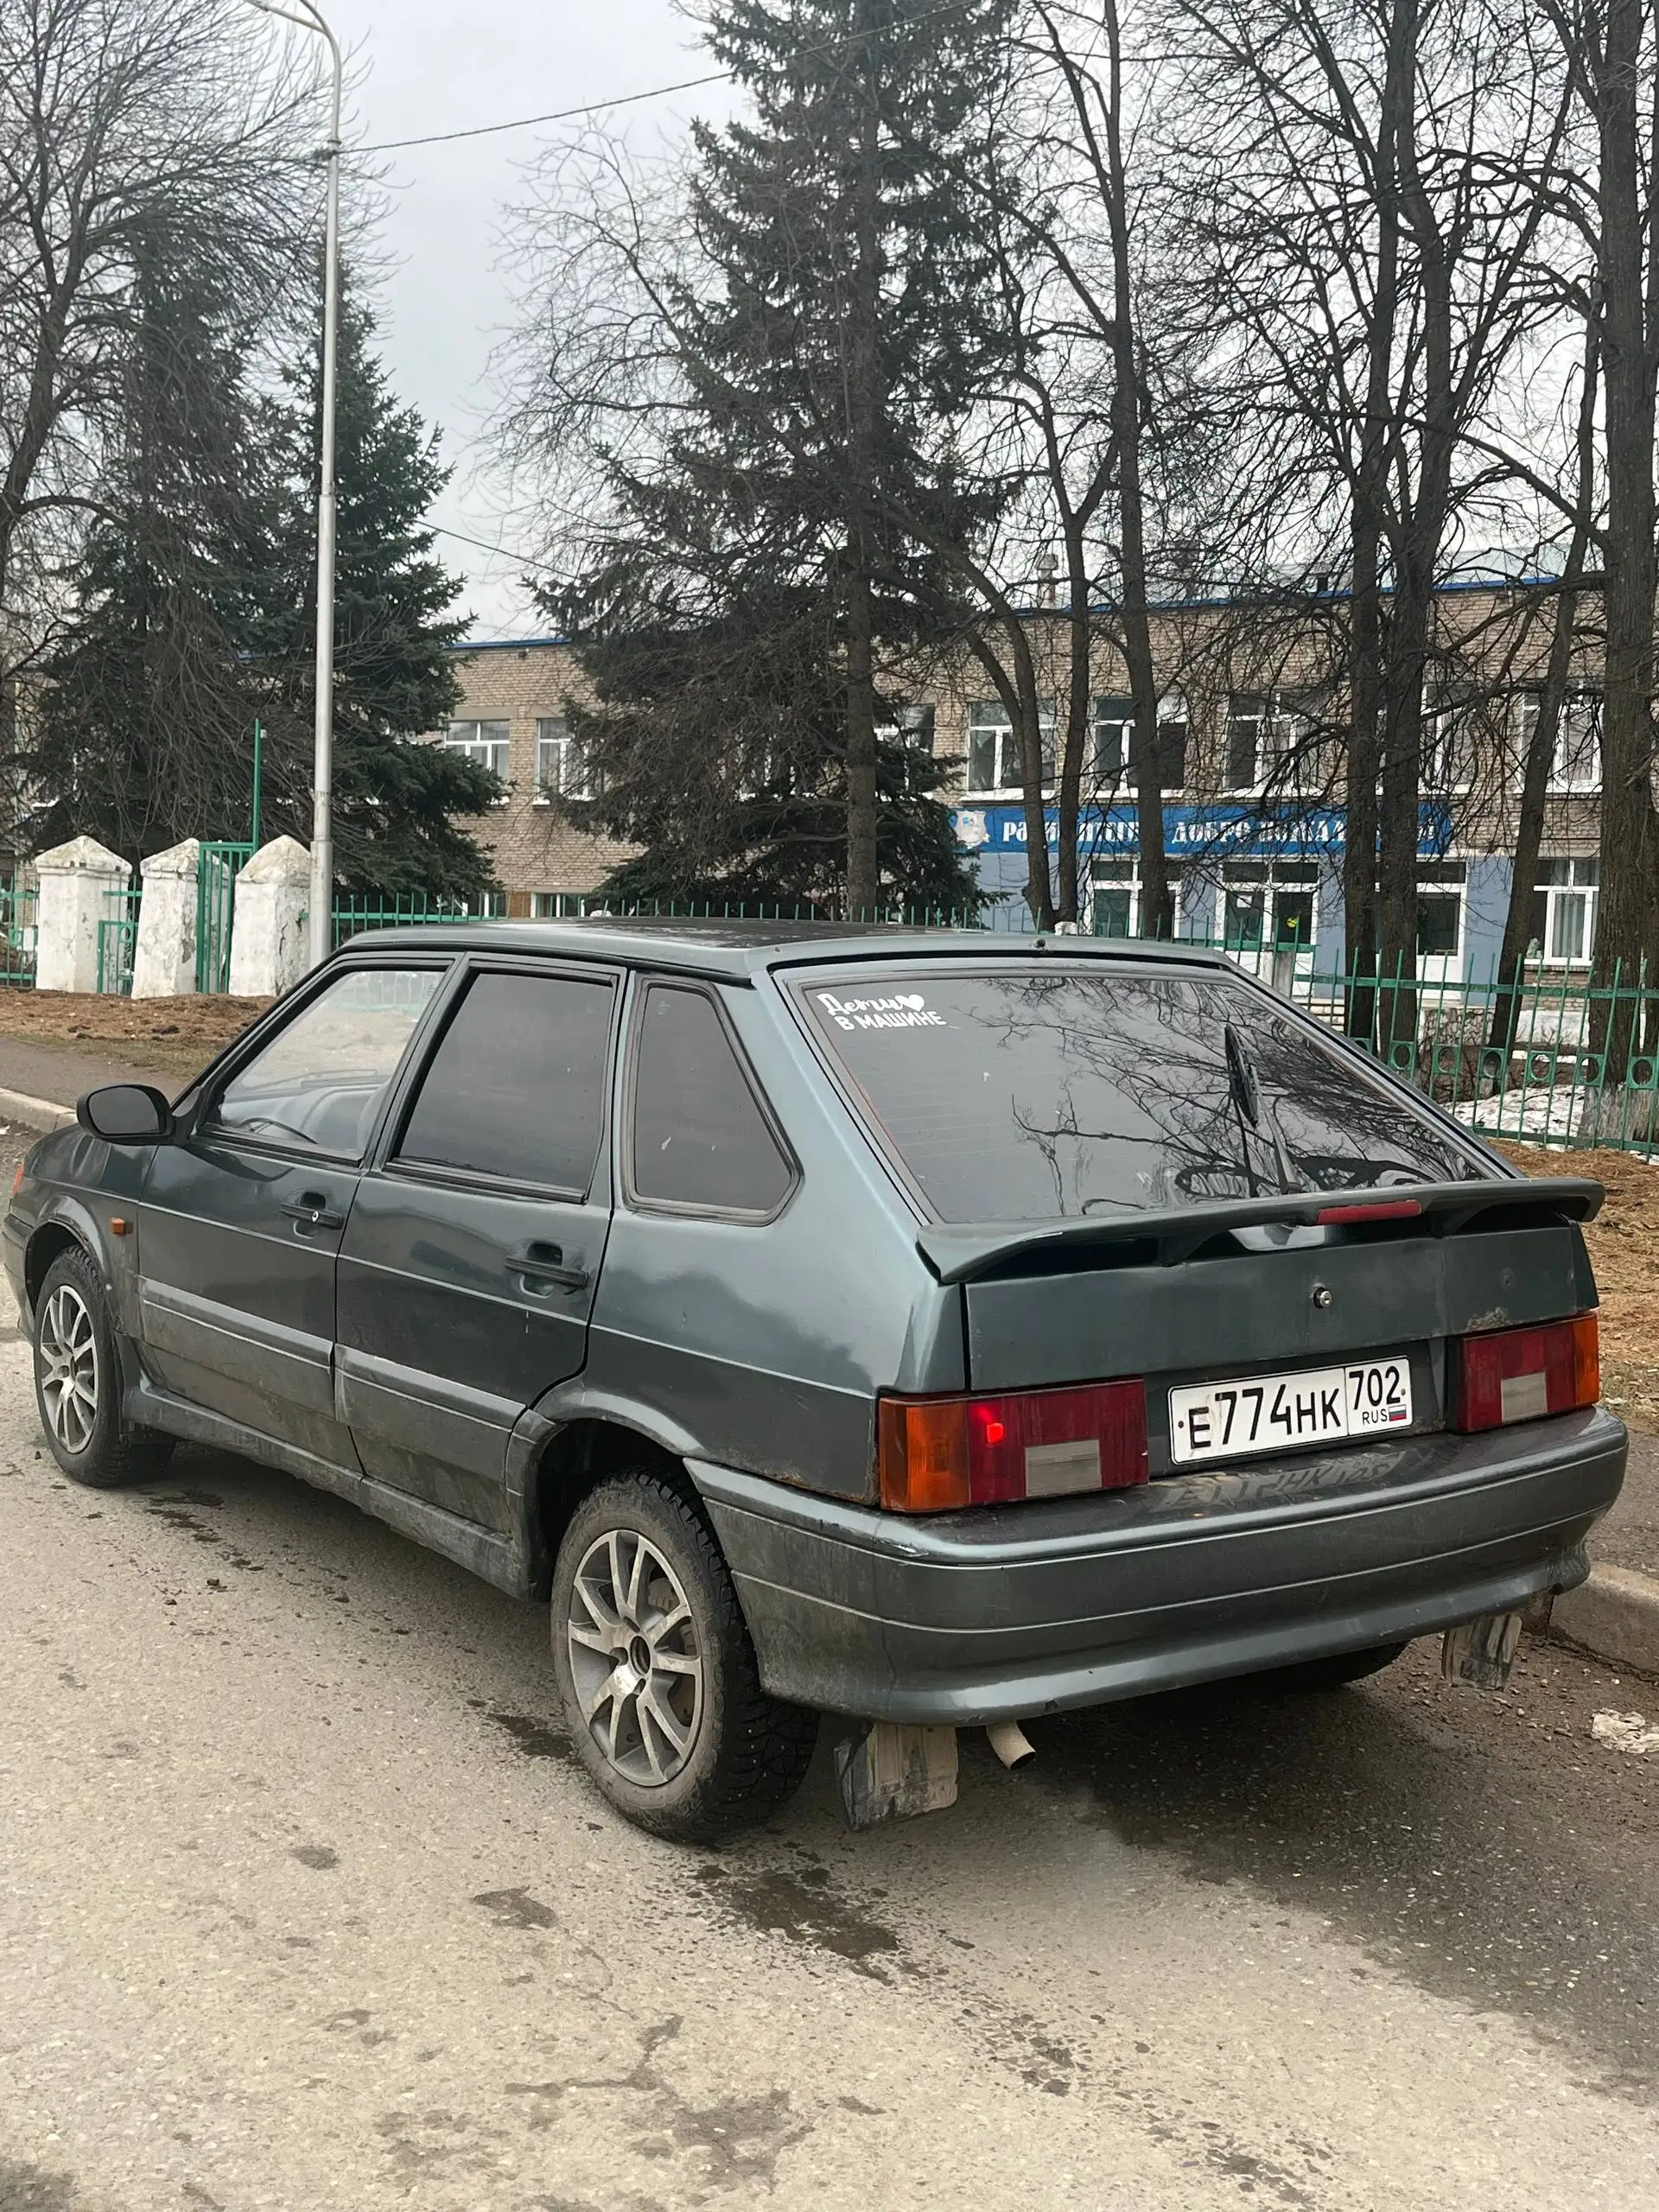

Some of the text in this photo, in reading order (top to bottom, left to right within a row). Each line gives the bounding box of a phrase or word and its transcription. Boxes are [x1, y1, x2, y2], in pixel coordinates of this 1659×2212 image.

[1171, 821, 1251, 844] ДОБРО
[854, 1010, 947, 1030] МАШИНЕ
[1349, 1365, 1401, 1411] 702
[1362, 1408, 1389, 1426] RUS
